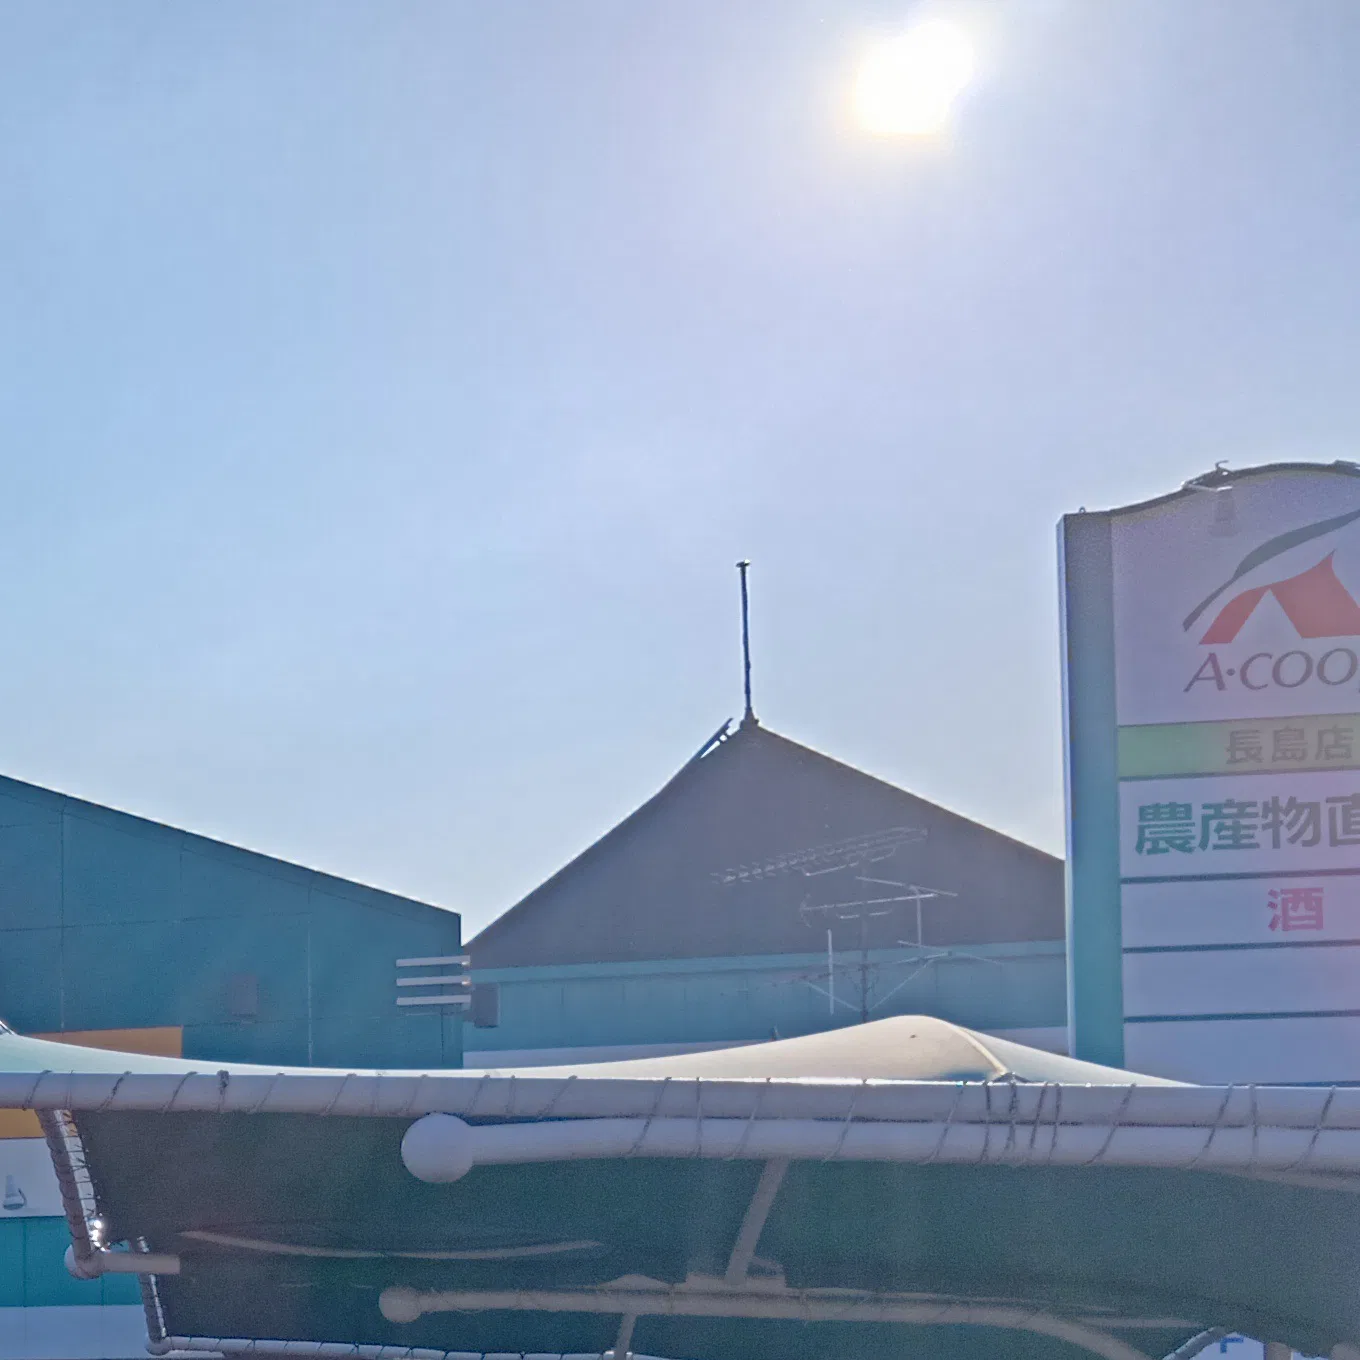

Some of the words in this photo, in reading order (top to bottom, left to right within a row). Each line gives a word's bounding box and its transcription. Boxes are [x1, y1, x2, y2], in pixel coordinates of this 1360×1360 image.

[1225, 725, 1353, 765] 長島店
[1267, 886, 1325, 932] 酒
